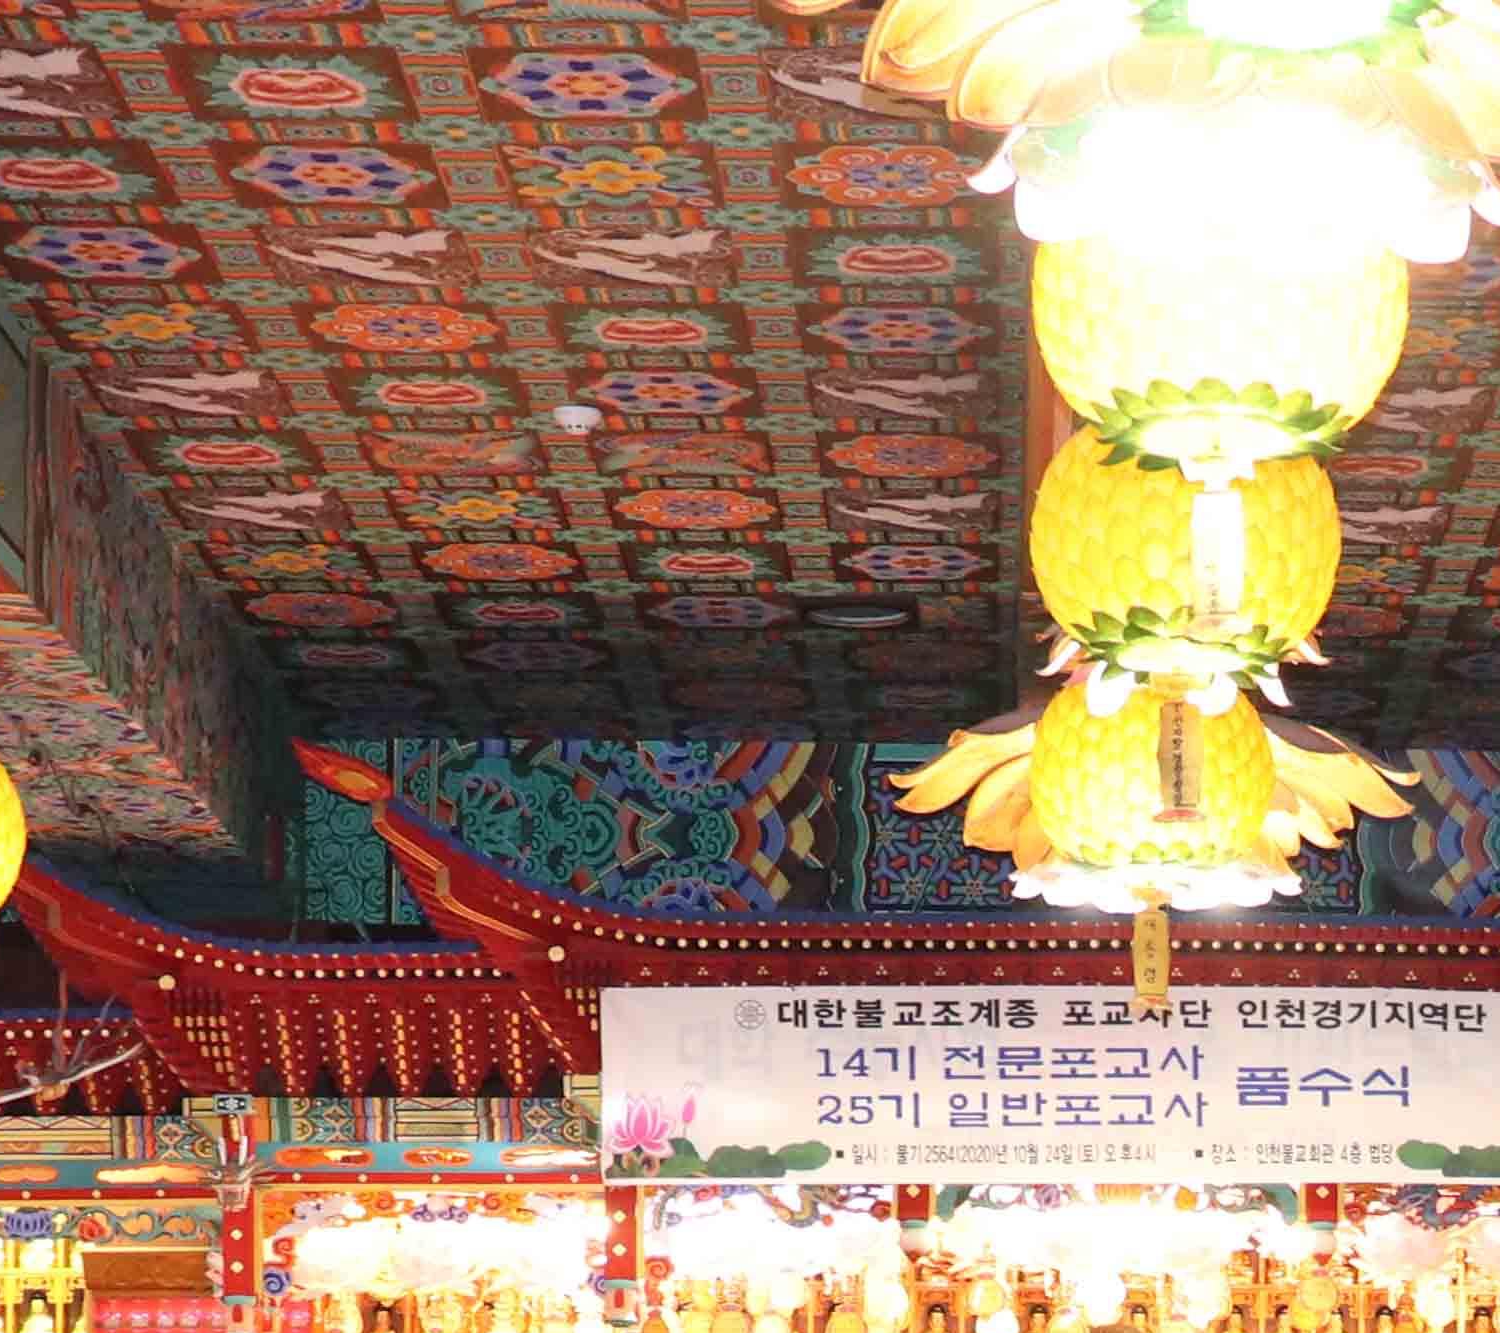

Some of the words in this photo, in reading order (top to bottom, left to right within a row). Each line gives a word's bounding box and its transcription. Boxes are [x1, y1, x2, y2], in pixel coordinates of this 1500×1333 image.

[777, 998, 1040, 1030] 대한불교조계종
[1062, 998, 1213, 1030] 포교사단
[1237, 999, 1488, 1033] 인천경기지역단
[815, 1045, 917, 1081] 14기
[942, 1044, 1206, 1081] 전문포교사
[1235, 1065, 1411, 1108] 품수식
[816, 1092, 921, 1129] 25기
[948, 1092, 1209, 1129] 일반포교사
[1211, 1143, 1237, 1164] 장소
